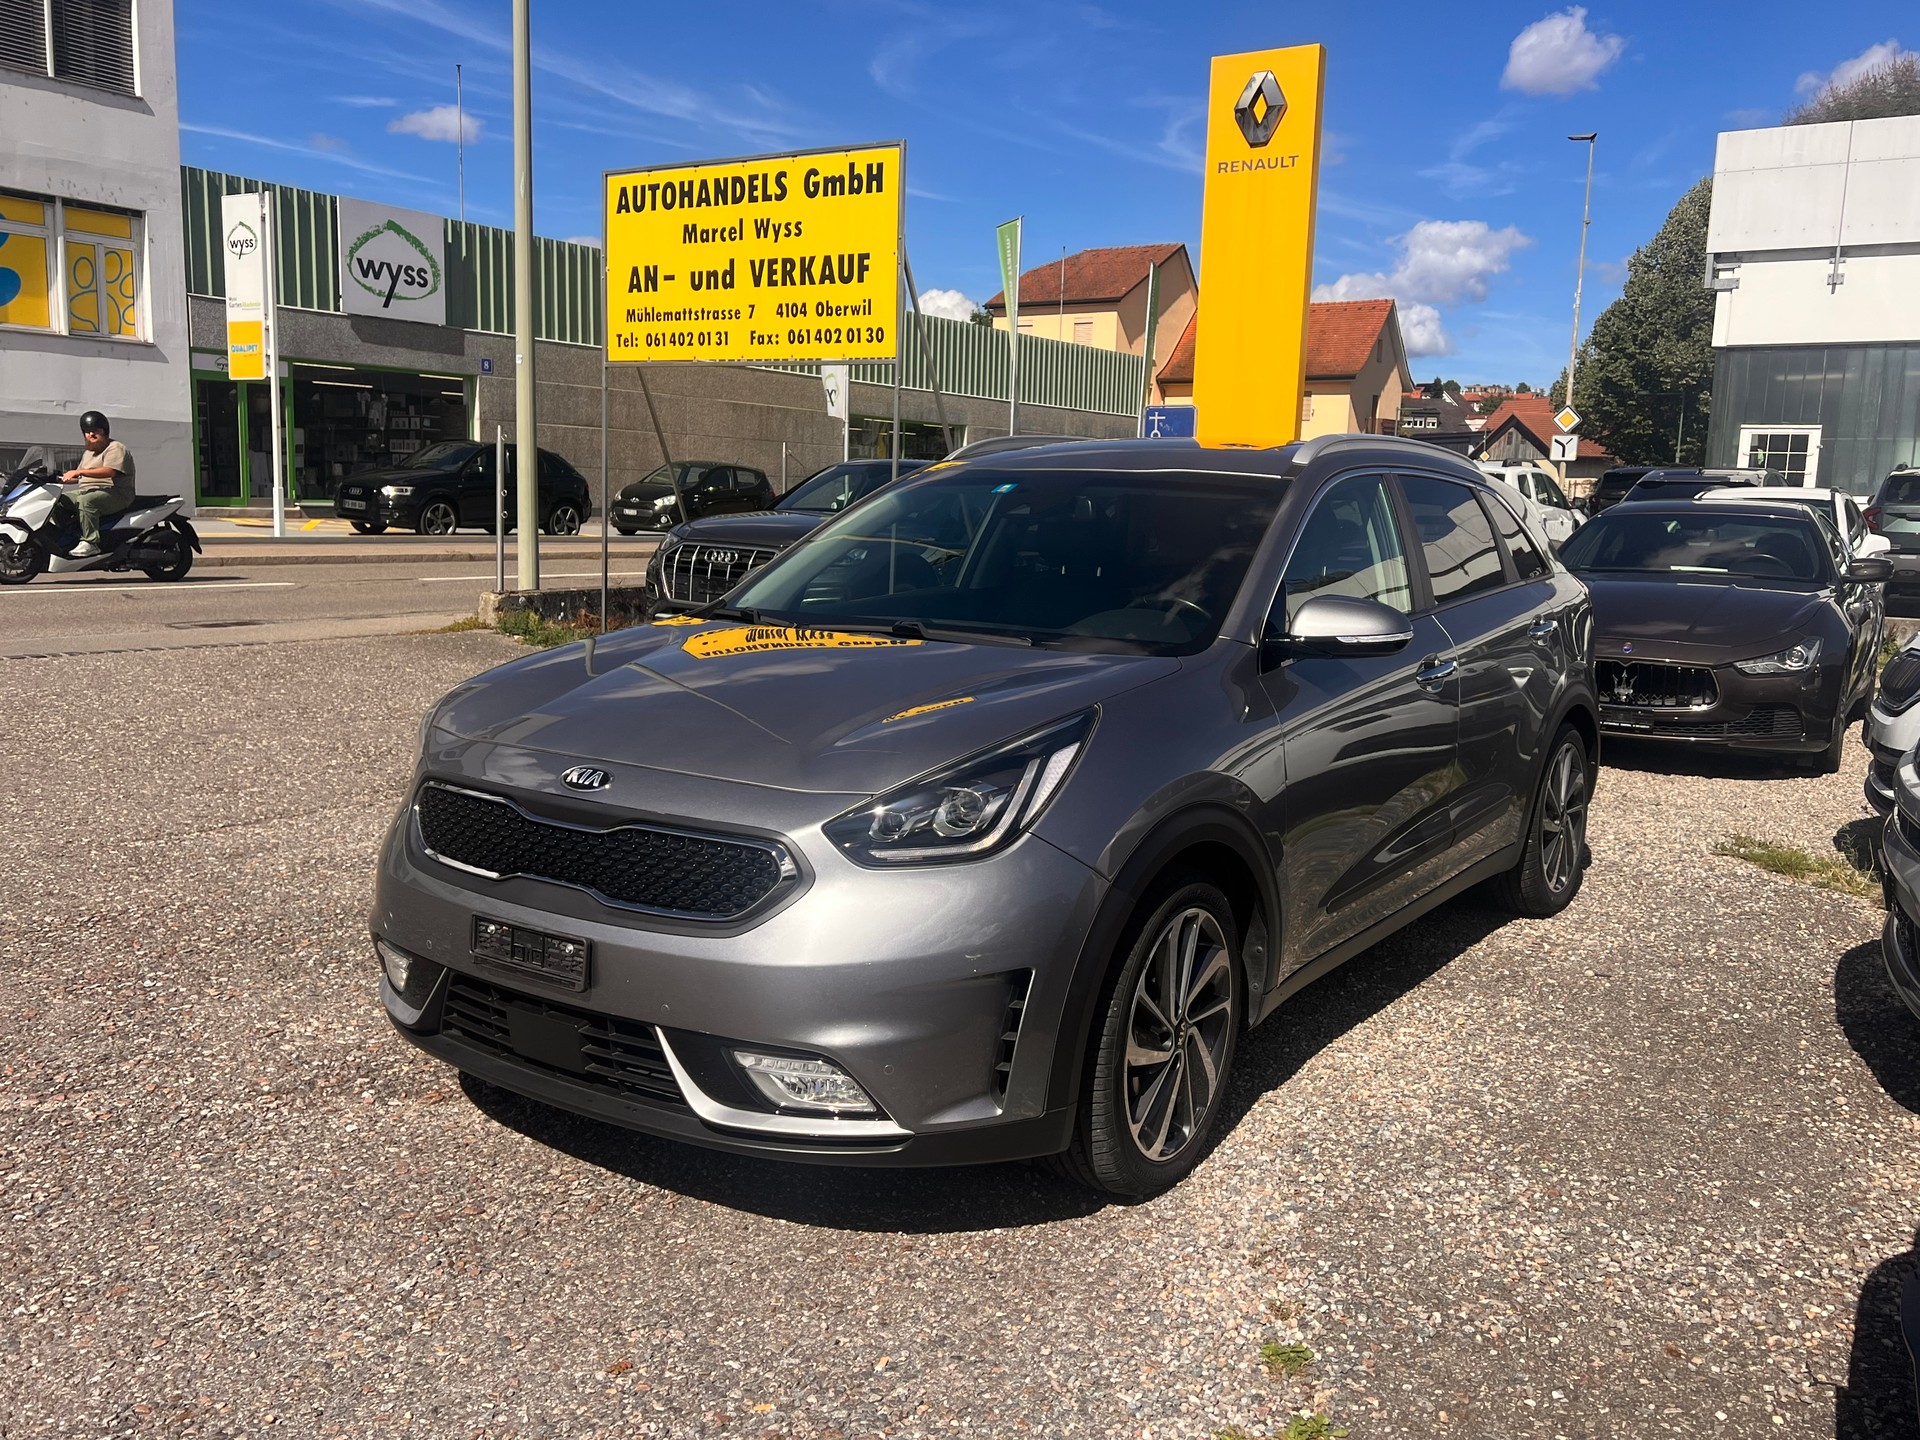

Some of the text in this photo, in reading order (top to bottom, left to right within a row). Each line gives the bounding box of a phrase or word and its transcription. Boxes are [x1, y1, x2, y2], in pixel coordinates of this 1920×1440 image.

[1218, 155, 1299, 174] RENAULT
[616, 162, 884, 214] AUTOHANDELS GmbH
[682, 217, 803, 244] Marcel Wyss
[230, 239, 254, 260] wyss
[356, 257, 429, 308] wyss
[627, 253, 871, 293] AN- und VERKAUF
[626, 299, 872, 323] Mühlemattstrasse 7 4104 Oberwil
[230, 344, 258, 353] QUALIPET
[616, 333, 639, 348] Tel:
[750, 330, 780, 345] Fax:
[565, 768, 604, 788] KIA
